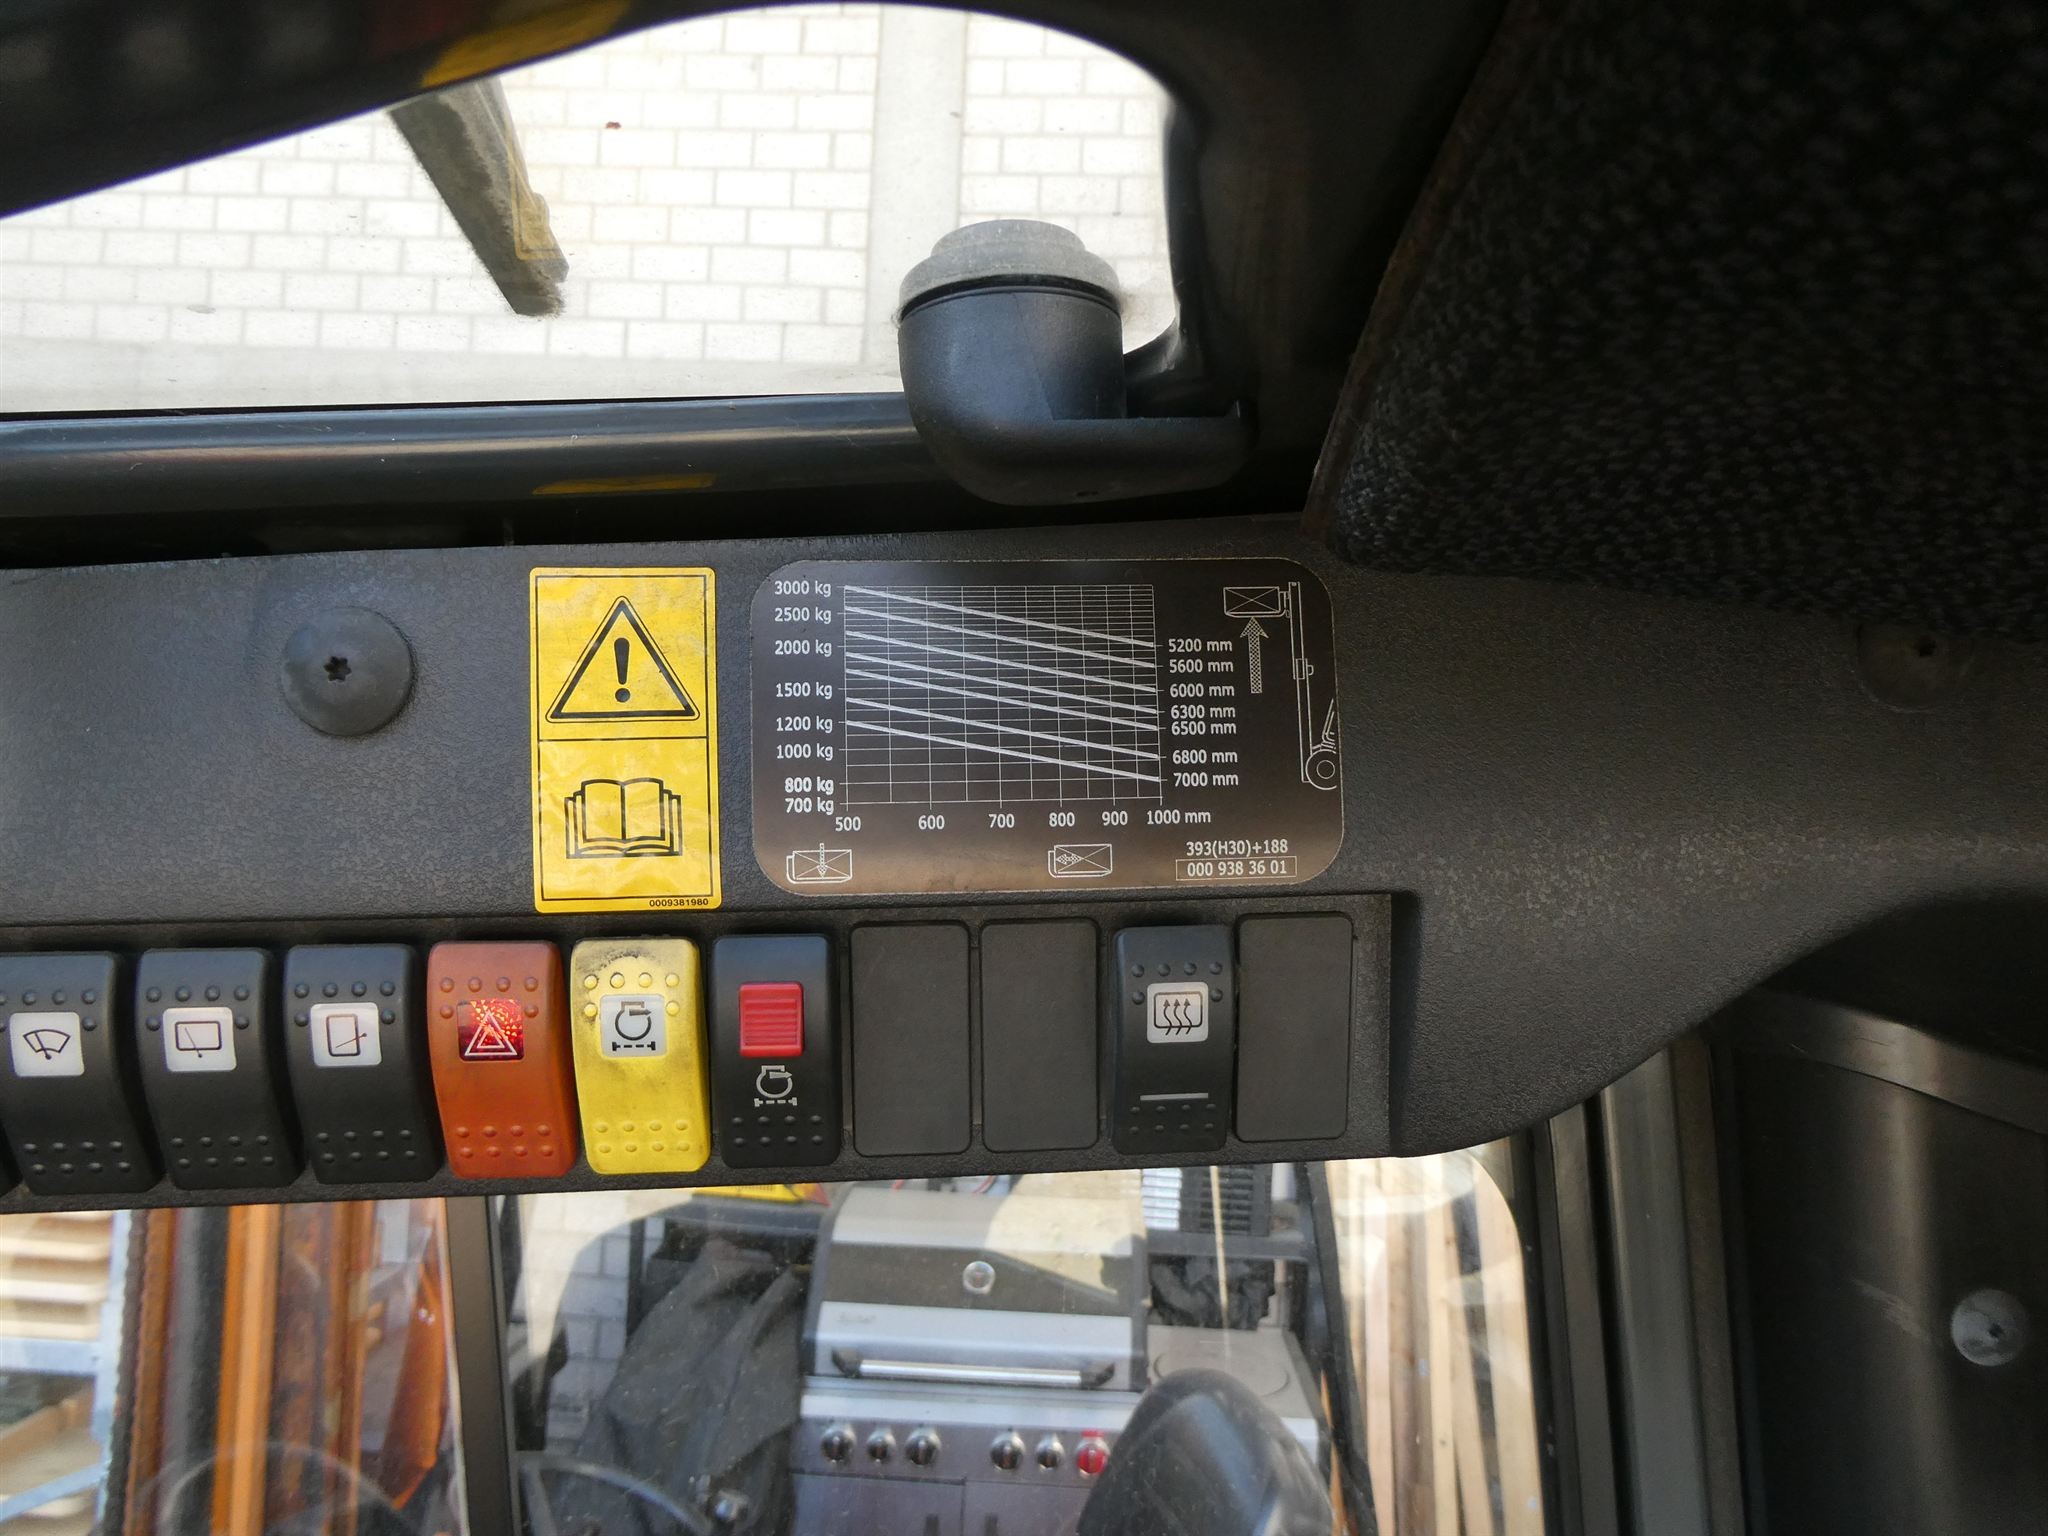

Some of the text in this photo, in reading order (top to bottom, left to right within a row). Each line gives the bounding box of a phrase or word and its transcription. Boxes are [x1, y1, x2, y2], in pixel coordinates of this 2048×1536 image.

[775, 581, 832, 597] 3000 kg
[775, 607, 832, 624] 2500 kg
[775, 639, 832, 657] 2000 kg
[1169, 639, 1232, 652] 5200 mm
[1170, 659, 1233, 673] 5600 mm
[776, 682, 832, 699] 1500 kg
[1170, 684, 1234, 697] 6000 mm
[1171, 705, 1235, 719] 6300 mm
[777, 716, 833, 733] 1200 kg
[1172, 721, 1236, 735] 6500 mm
[777, 743, 833, 761] 1000 kg
[1173, 750, 1237, 764] 6800 mm
[785, 777, 834, 795] 800 kg
[1174, 772, 1238, 787] 7000 mm
[785, 797, 834, 815] 700 kg
[836, 817, 861, 831] 500
[919, 815, 944, 829] 600
[989, 814, 1014, 828] 700
[1049, 812, 1075, 827] 800
[1102, 811, 1128, 825] 900
[1147, 810, 1211, 824] 1000 mm
[1186, 838, 1288, 859] 393(H30)+188
[1188, 860, 1287, 876] 000 938 36 01
[649, 897, 709, 911] 0009381980
